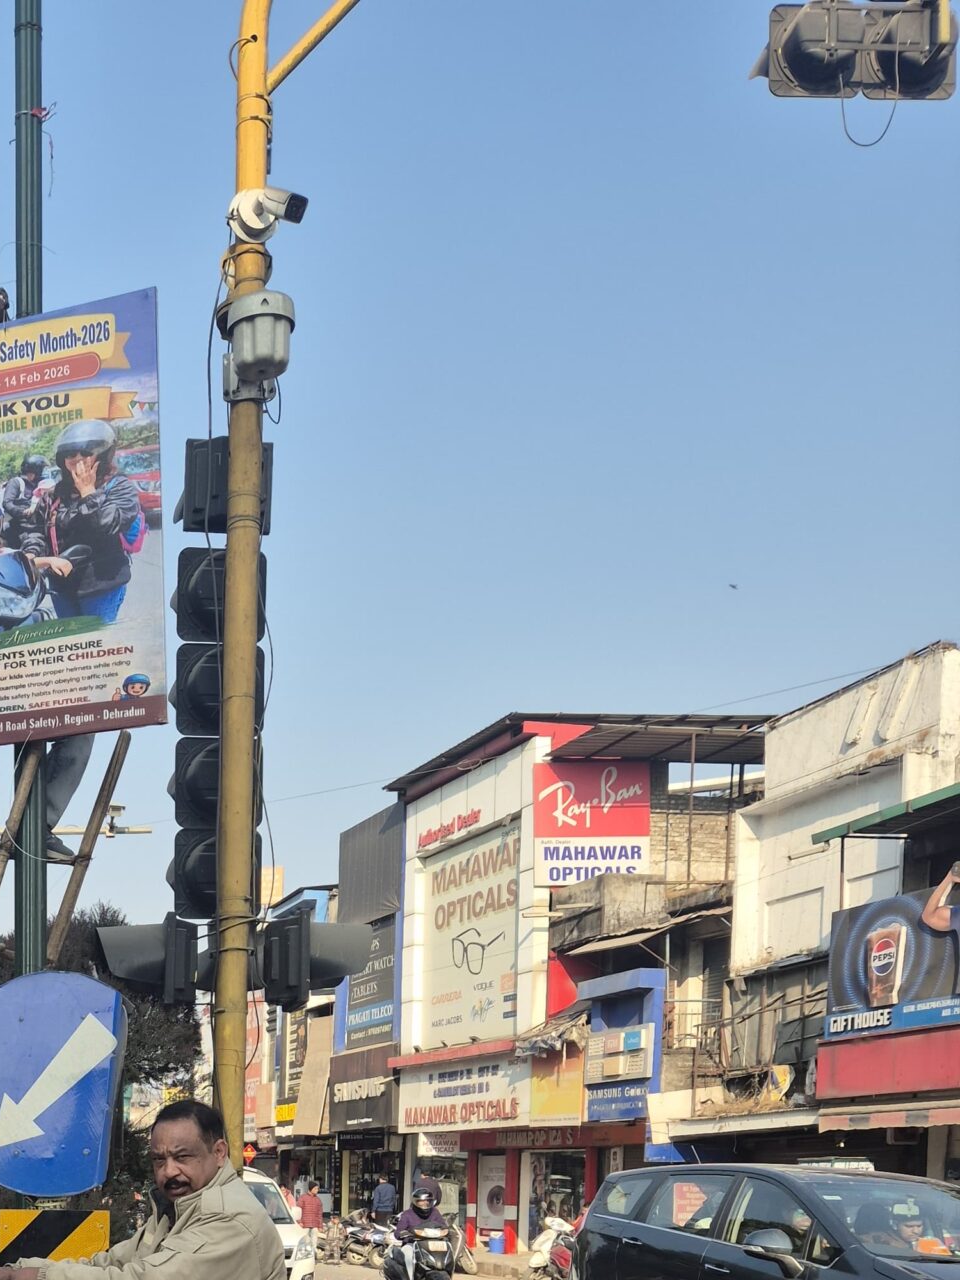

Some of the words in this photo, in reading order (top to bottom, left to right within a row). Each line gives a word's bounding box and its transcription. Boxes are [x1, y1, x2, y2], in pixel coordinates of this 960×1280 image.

[0, 339, 36, 363] Safety
[40, 321, 109, 356] Month-2026
[4, 376, 17, 388] 14
[20, 370, 40, 385] Feb
[45, 365, 70, 380] 2026
[19, 393, 69, 413] YOU
[32, 408, 83, 427] MOTHER
[4, 625, 64, 645] Appreciate
[4, 660, 27, 670] FOR
[29, 656, 64, 667] THEIR
[67, 646, 134, 661] CHILDREN
[27, 647, 55, 657] WHO
[58, 640, 103, 652] ENSURE
[5, 717, 27, 731] Road
[64, 712, 94, 728] Region
[103, 707, 145, 720] Dehradun
[457, 808, 481, 831] Dealer
[544, 845, 642, 861] MAHAWAR
[435, 879, 518, 930] OPTICALS
[873, 952, 895, 962] PEPSI
[432, 990, 462, 1005] CARRERA
[432, 1017, 444, 1028] MARC
[446, 1015, 462, 1026] JACOBS
[334, 1076, 386, 1103] SAMSUNG
[589, 1088, 621, 1099] SAMSUNG
[405, 1104, 457, 1127] MAHAWAR
[460, 1098, 518, 1121] OPTICALS
